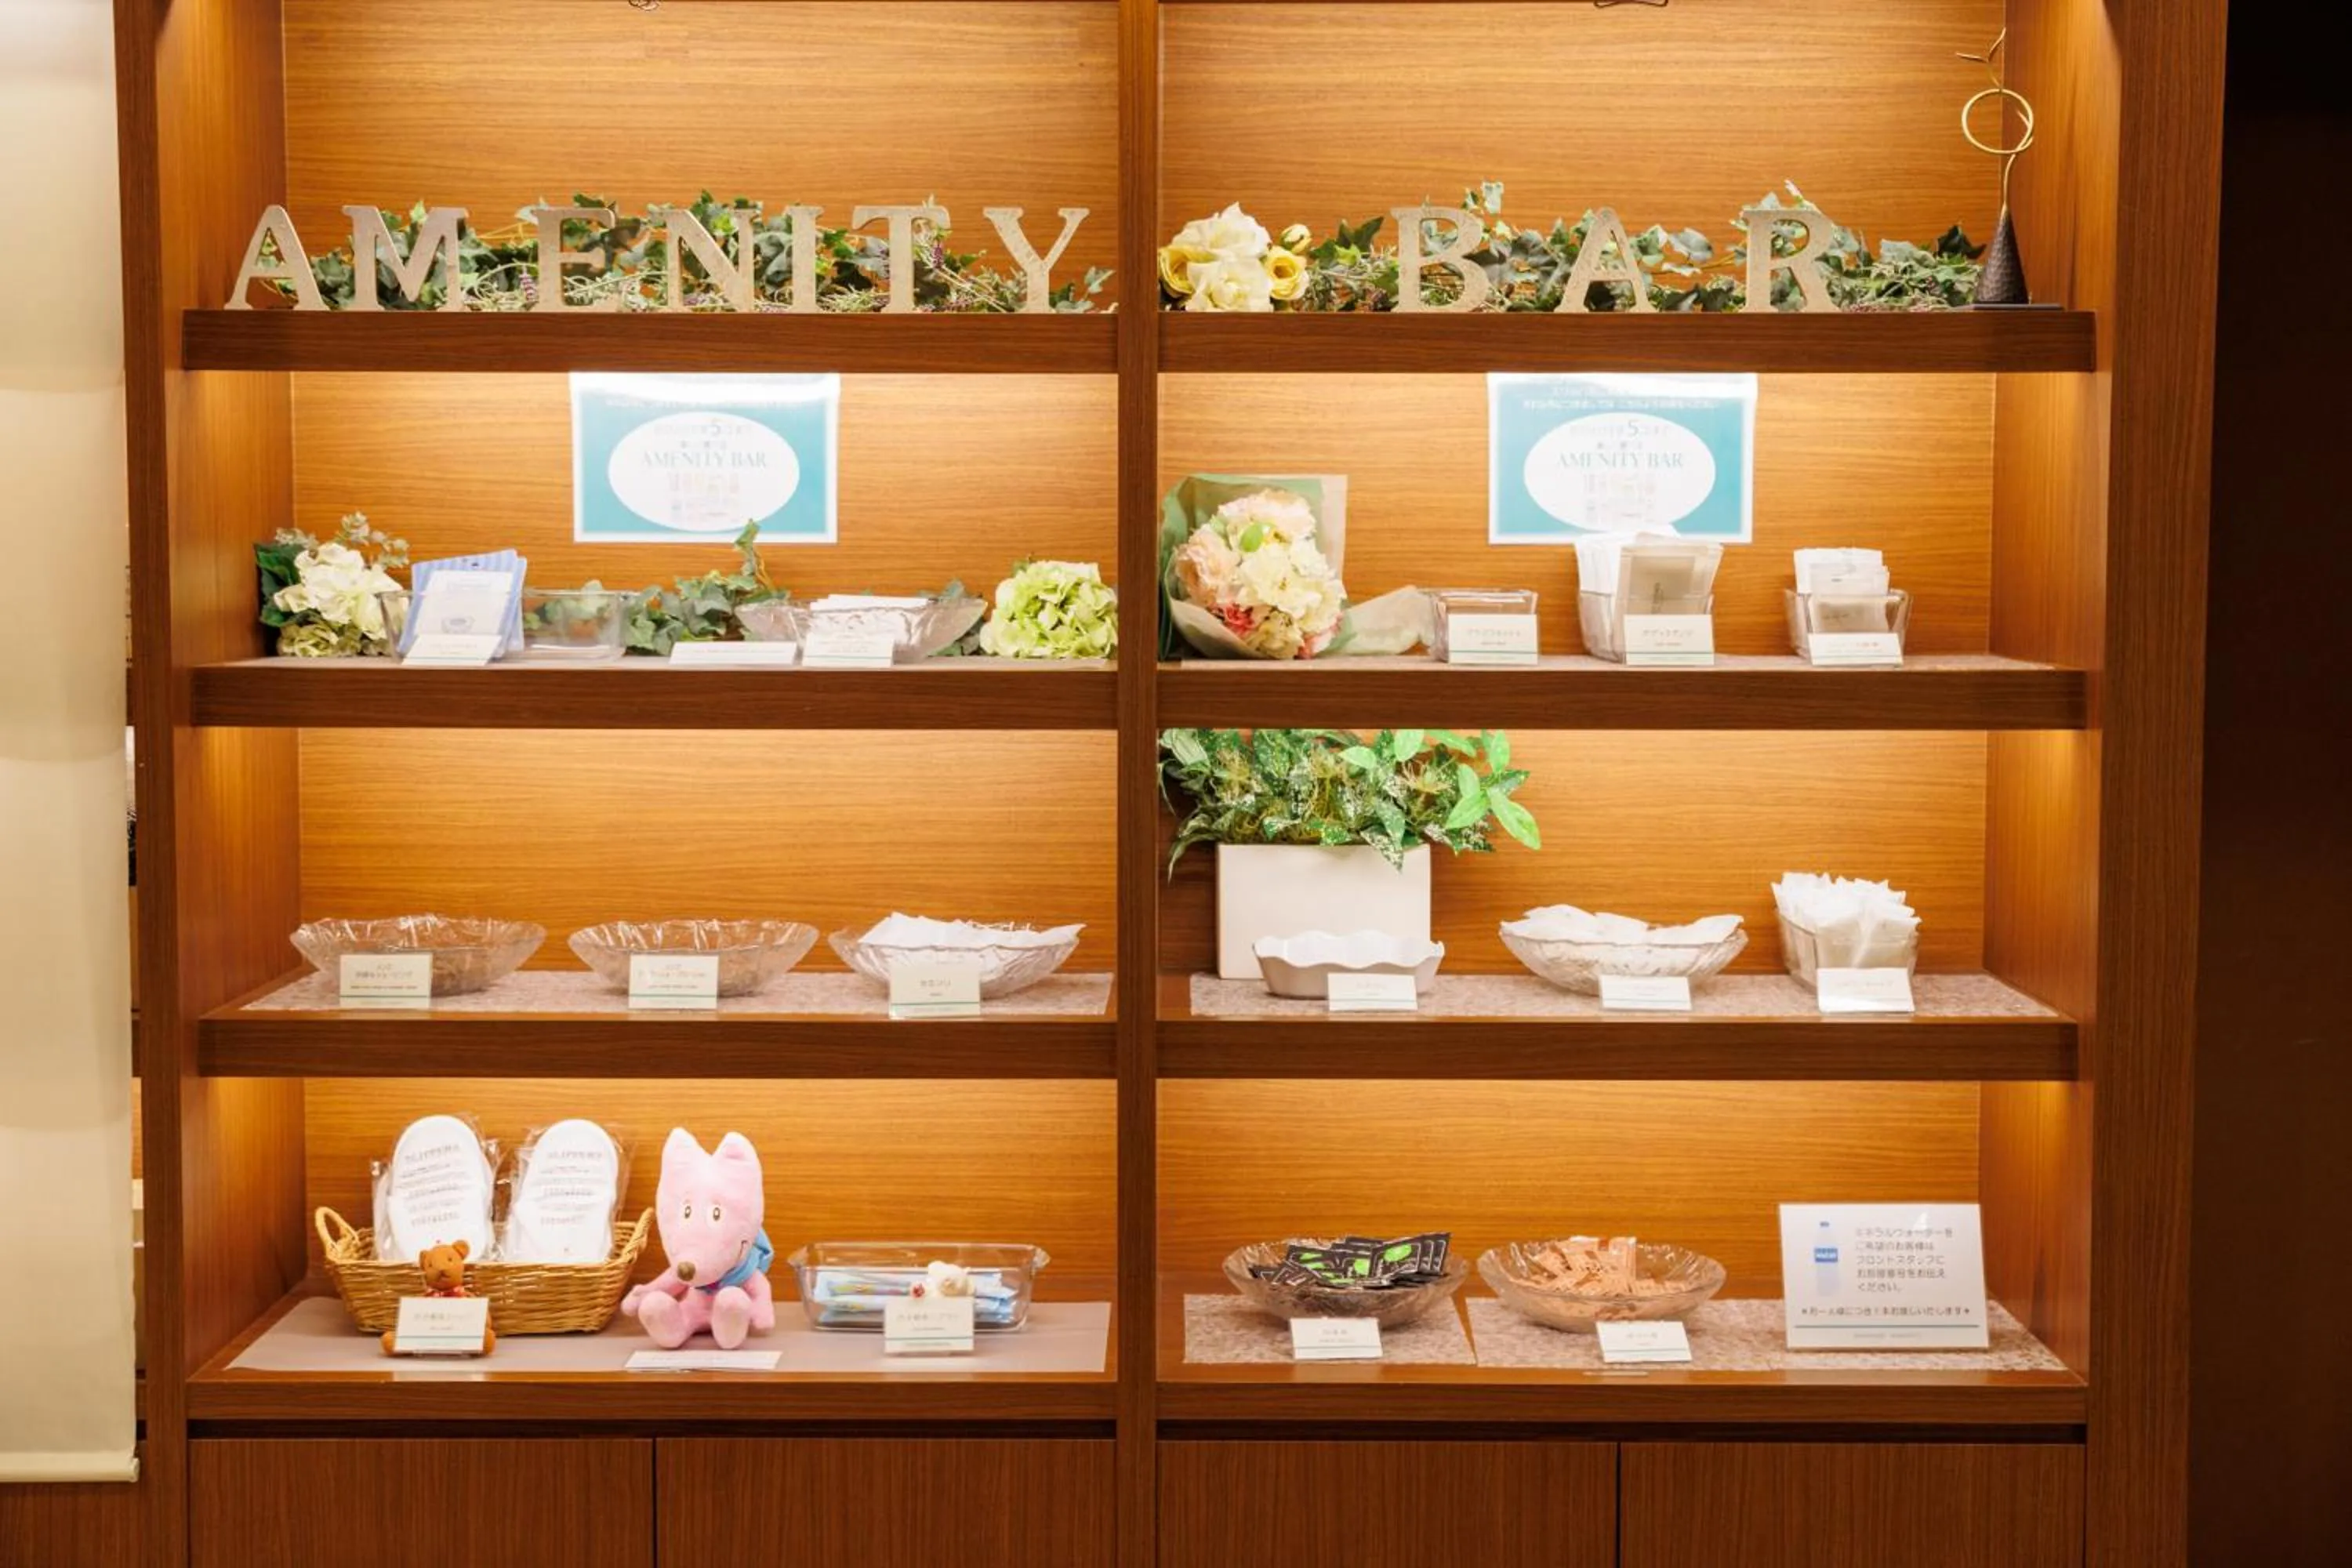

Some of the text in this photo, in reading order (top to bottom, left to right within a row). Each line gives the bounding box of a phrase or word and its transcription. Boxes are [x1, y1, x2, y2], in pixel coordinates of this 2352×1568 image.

[224, 204, 1842, 313] AMENITY BAR
[641, 451, 767, 468] AMENITY BAR
[1556, 451, 1684, 469] AMENITY BAR
